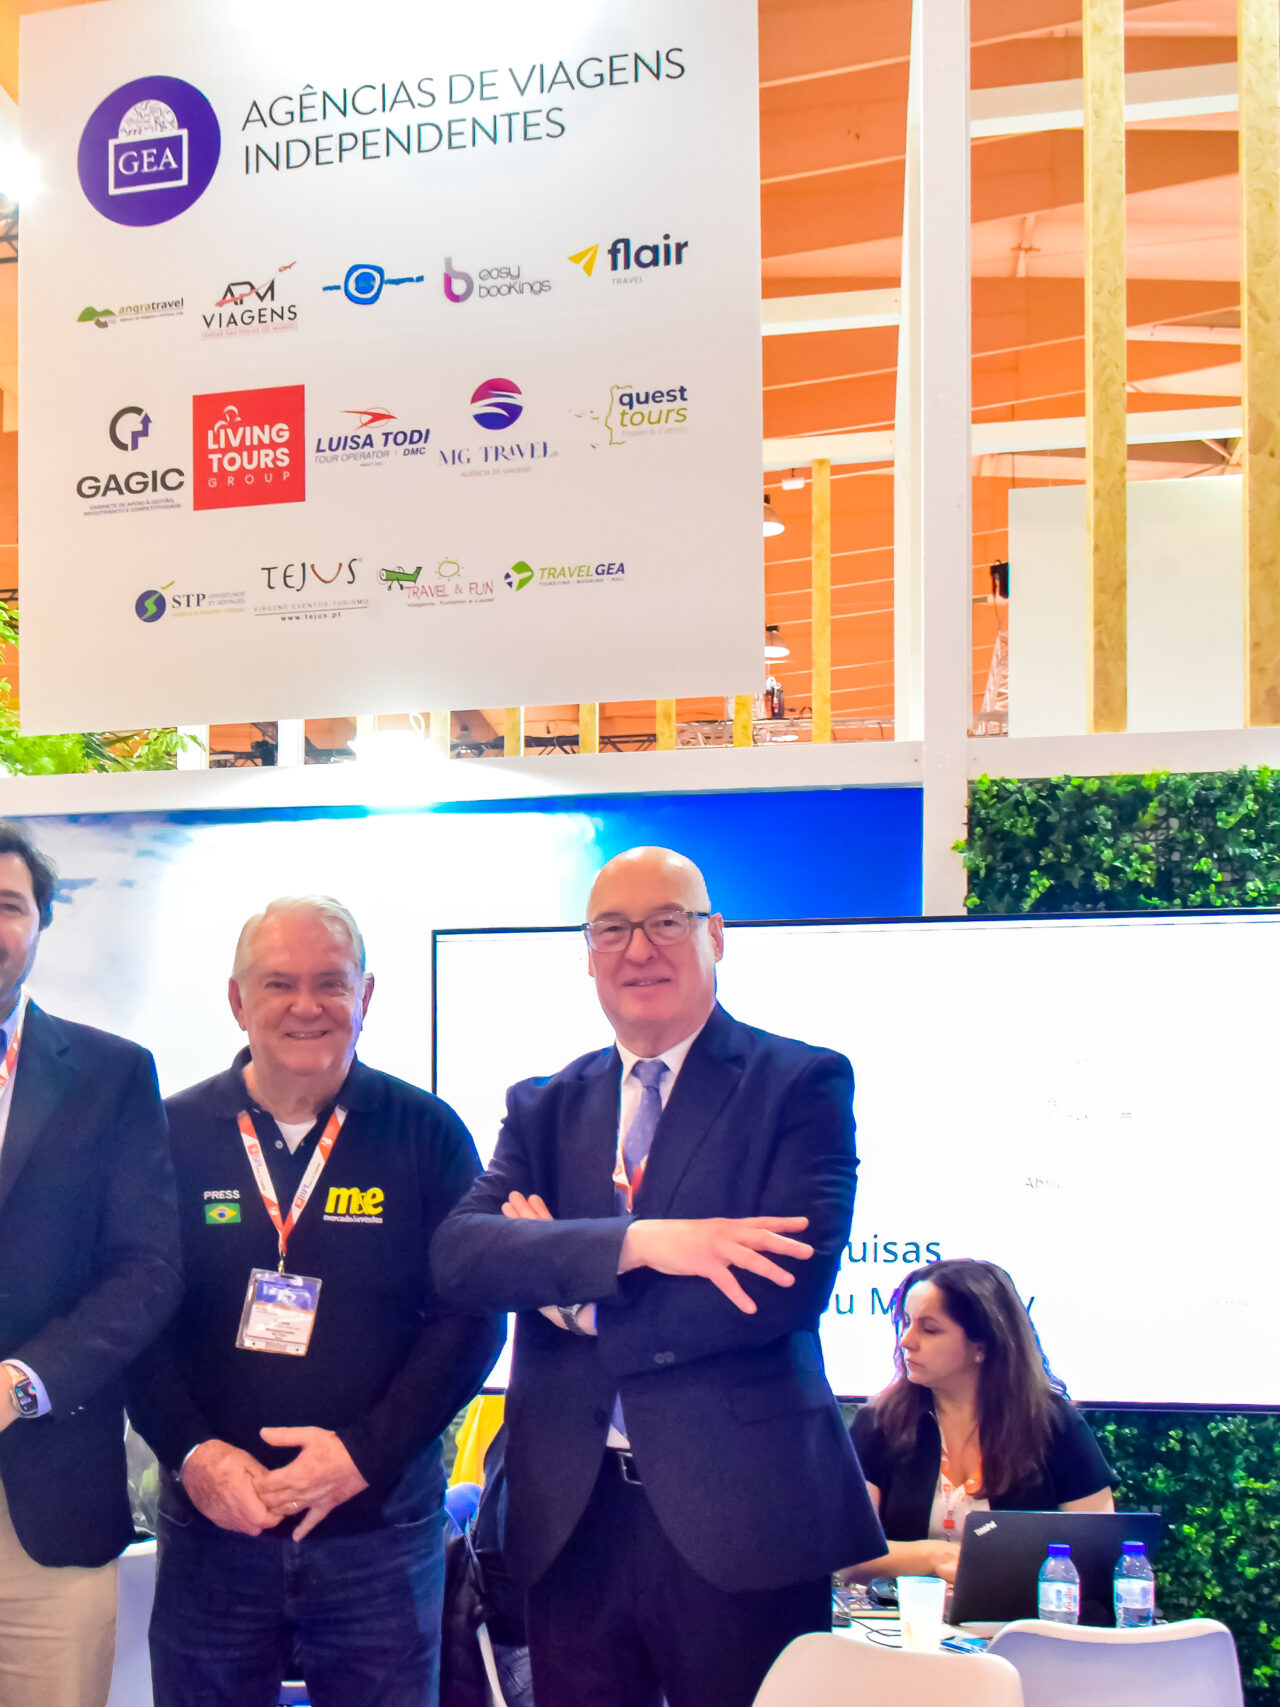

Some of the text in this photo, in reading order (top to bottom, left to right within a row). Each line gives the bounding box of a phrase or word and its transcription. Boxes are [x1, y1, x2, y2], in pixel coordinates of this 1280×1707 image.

[241, 47, 686, 131] AGÊNCIAS DE VIAGENS
[243, 107, 567, 176] INDEPENDENTES
[118, 147, 179, 176] GEA
[608, 233, 689, 271] flair
[478, 265, 521, 282] easy
[611, 276, 644, 285] TRAVEL
[478, 279, 552, 299] bookings
[118, 297, 184, 315] angratravel
[202, 304, 298, 330] VIAGENS
[618, 385, 688, 410] quest
[619, 407, 688, 428] tours
[207, 422, 290, 450] LIVING
[315, 428, 431, 454] LUISA TODI
[207, 447, 290, 474] TOURS
[314, 446, 426, 465] TOUR OPERATOR DMC
[439, 441, 554, 466] MG TRAVEL
[76, 467, 185, 499] GAGIC
[207, 471, 290, 488] GROUP
[260, 558, 358, 592] TEJUS
[171, 592, 206, 609] STP
[404, 579, 494, 600] TRAVEL & FUN
[203, 1189, 241, 1200] PRESS
[841, 1233, 942, 1266] uisas
